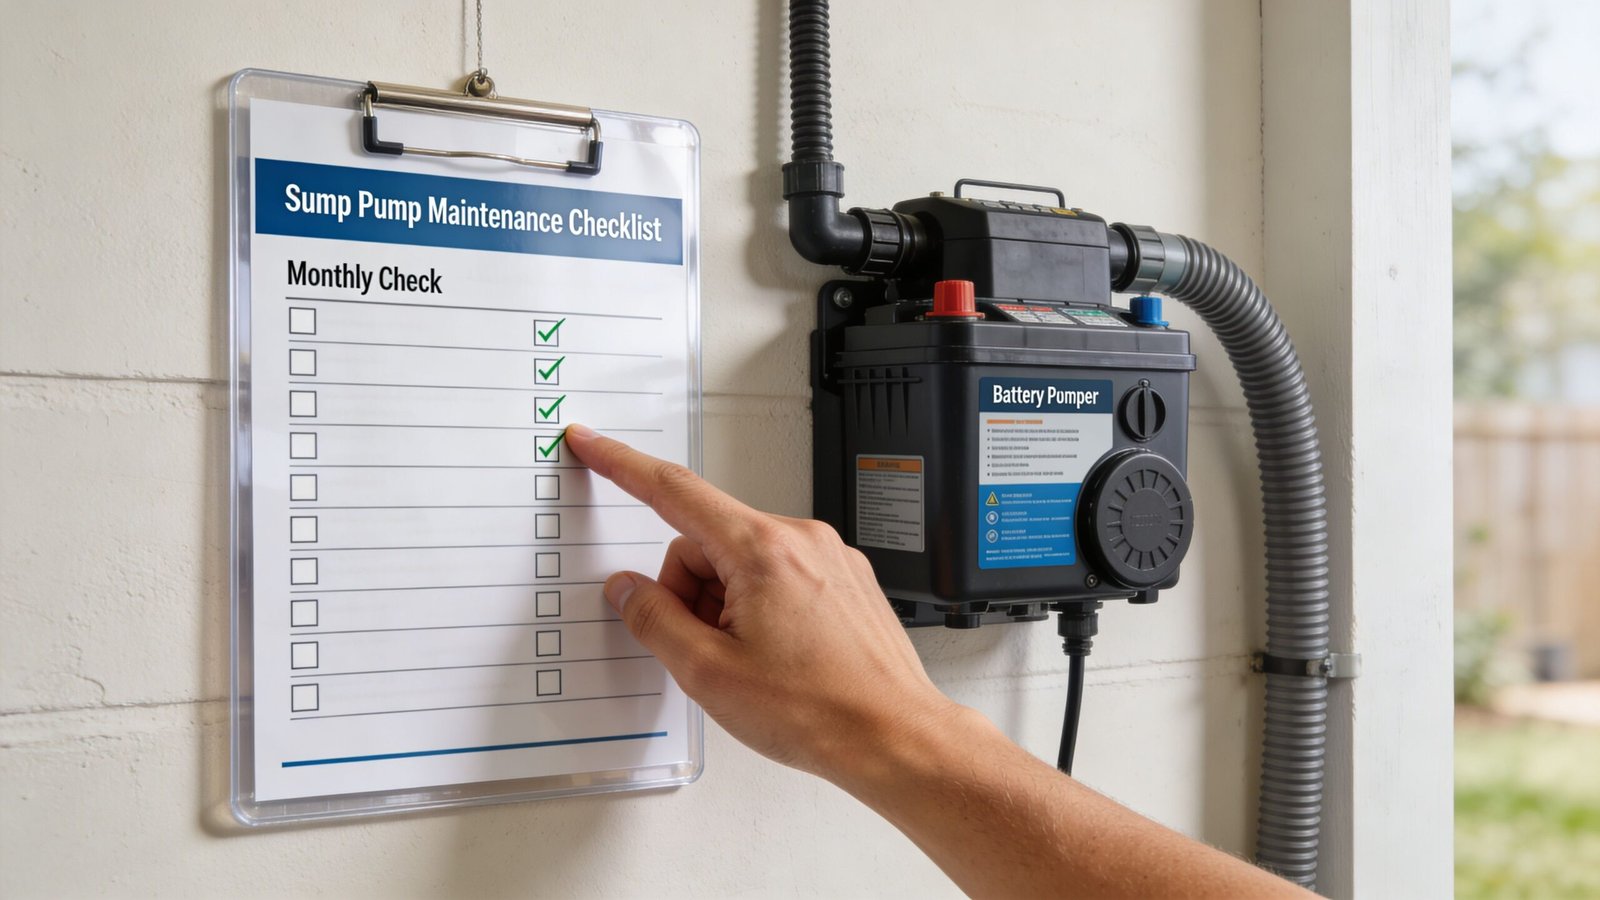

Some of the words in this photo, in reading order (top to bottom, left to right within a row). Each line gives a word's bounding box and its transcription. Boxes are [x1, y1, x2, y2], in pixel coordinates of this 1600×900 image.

[285, 184, 351, 218] Sump
[358, 191, 421, 228] Pump
[429, 196, 563, 233] Maintenance
[569, 208, 662, 242] Checklist
[288, 260, 373, 295] Monthly
[379, 267, 442, 294] Check
[993, 385, 1045, 408] Battery
[1047, 386, 1099, 409] Pumper
